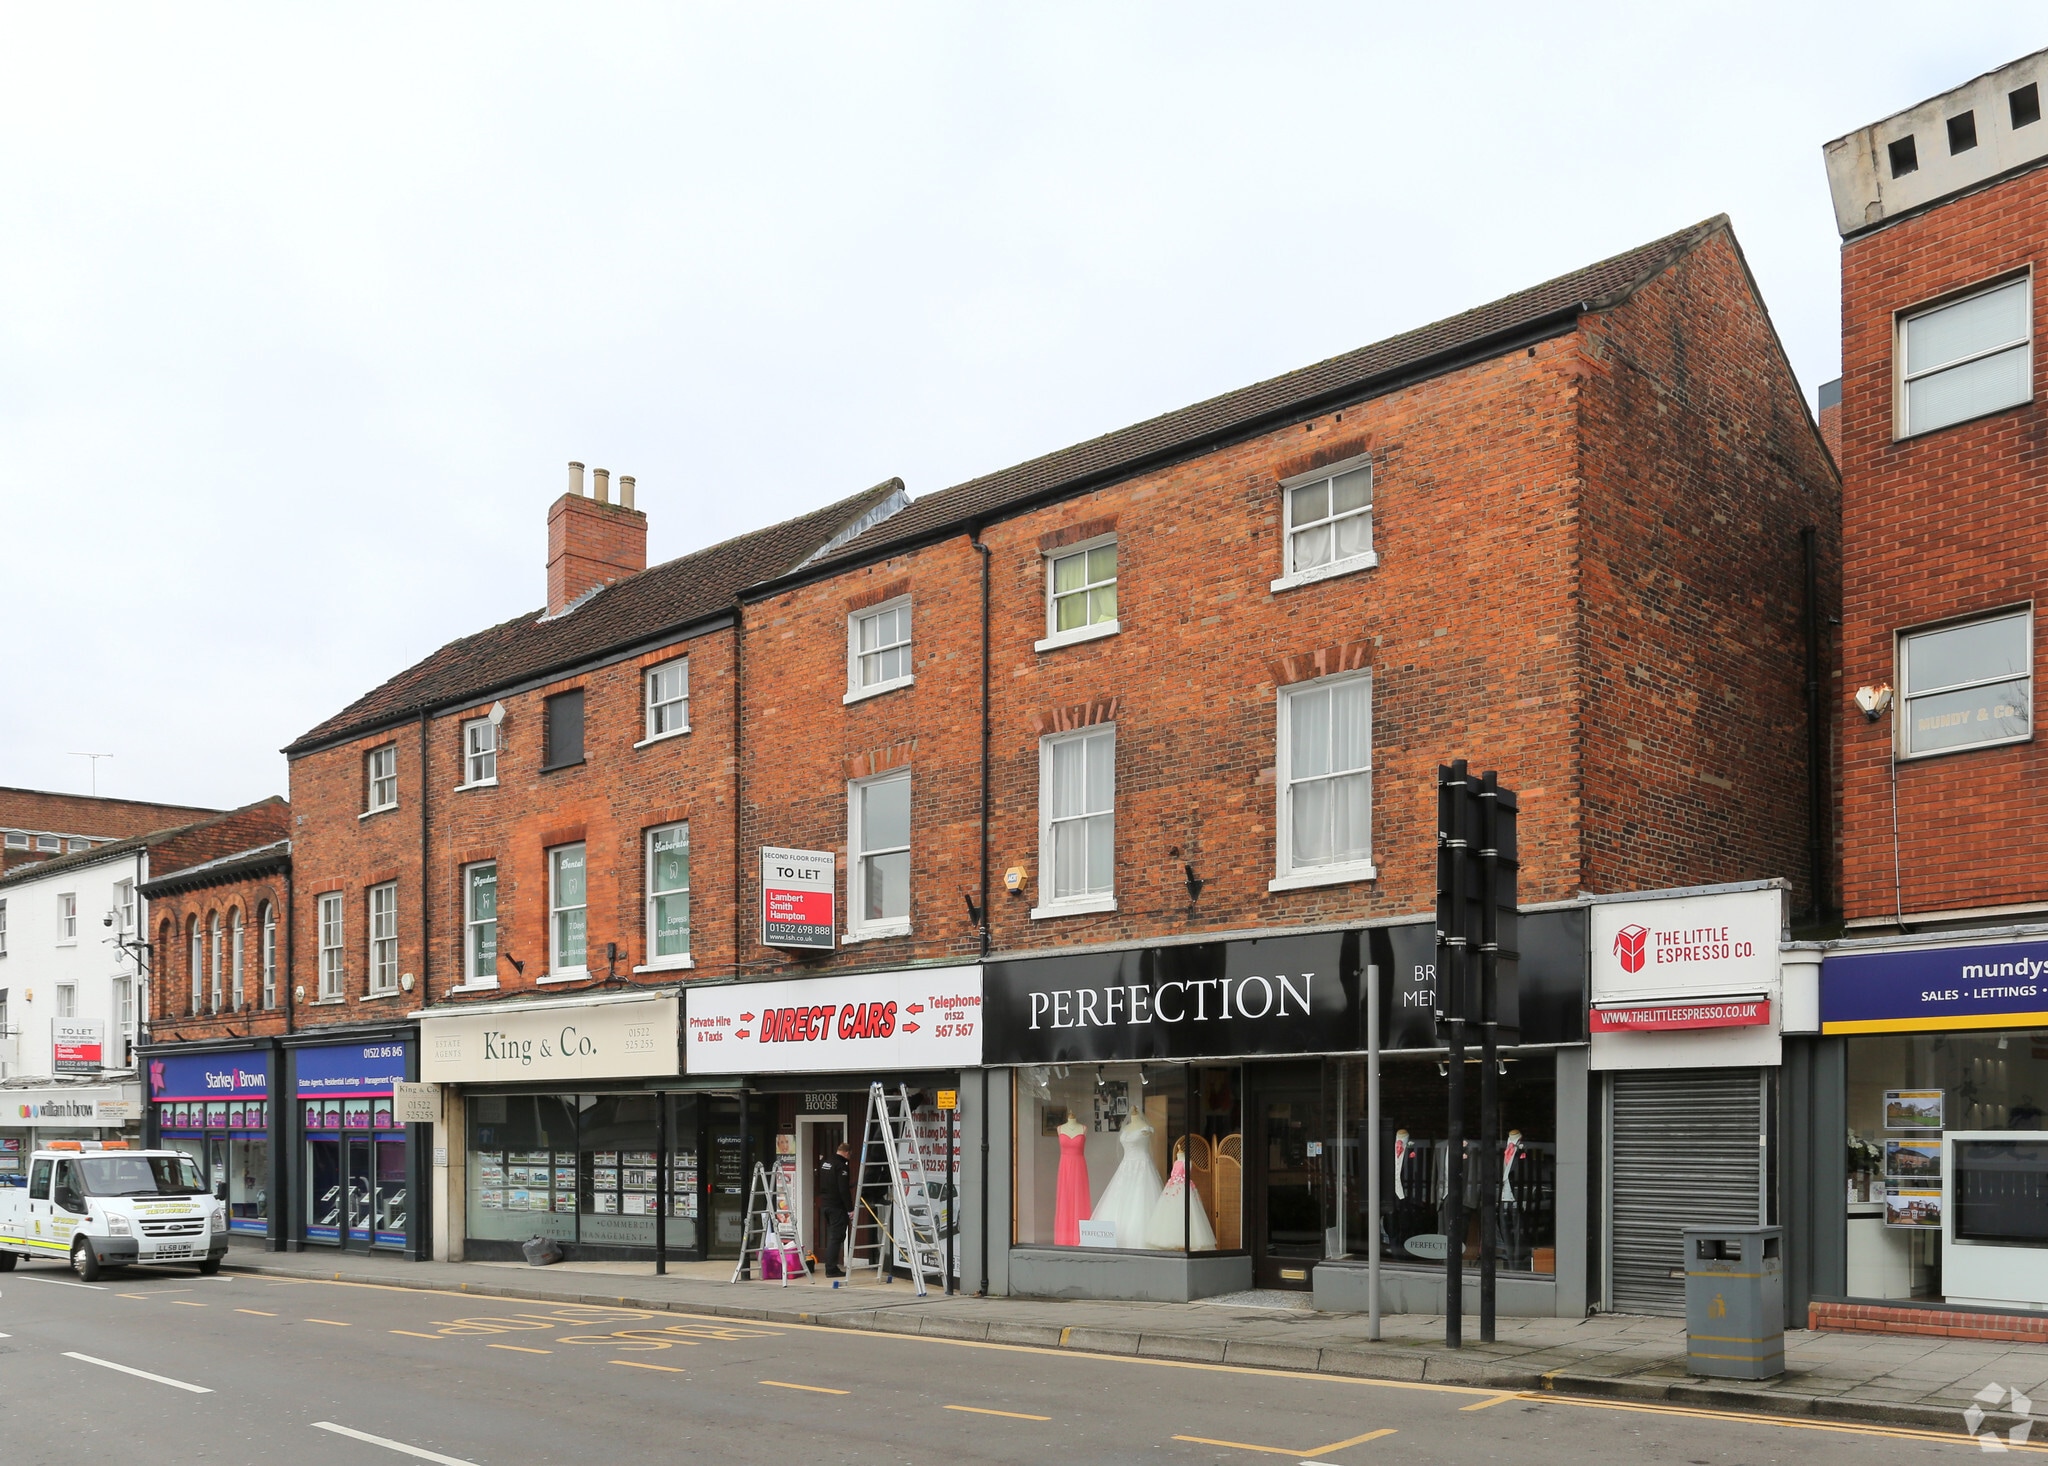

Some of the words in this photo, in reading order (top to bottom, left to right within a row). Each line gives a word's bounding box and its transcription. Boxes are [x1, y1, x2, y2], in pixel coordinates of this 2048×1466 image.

[1918, 710, 1971, 732] MUNDY
[1976, 708, 1989, 722] &
[1993, 705, 2019, 718] Co.
[654, 840, 690, 853] Laborator
[561, 858, 584, 870] Dental
[764, 852, 789, 860] SECOND
[790, 854, 810, 862] FLOOR
[810, 856, 834, 864] OFFICES
[776, 867, 794, 878] TO
[798, 869, 820, 880] LET
[770, 892, 804, 903] Lambert
[770, 902, 793, 911] Smith
[667, 916, 688, 925] Express
[770, 911, 806, 921] Hampton
[573, 922, 585, 931] Days
[659, 928, 679, 938] Denture
[679, 927, 690, 935] Rep
[769, 923, 796, 933] 01522
[797, 925, 813, 935] 698
[814, 926, 831, 936] 888
[572, 933, 585, 941] week
[769, 934, 813, 942] www.lsh.co.uk
[1655, 931, 1680, 946] THE
[1684, 926, 1729, 945] LITTLE
[1656, 943, 1730, 964] ESPRESSO
[1734, 941, 1756, 958] CO.
[1414, 964, 1436, 981] BR
[1403, 990, 1436, 1007] MEN
[1921, 989, 1959, 1002] SALES
[1973, 985, 2037, 999] LETTINGS
[928, 994, 981, 1010] Telephone
[1028, 973, 1315, 1031] PERFECTION
[944, 1011, 965, 1021] 01522
[1601, 1005, 1757, 1025] WWW.THELITTLEESPRESSO.CO.UK
[689, 1017, 715, 1028] Private
[716, 1016, 731, 1027] Hire
[759, 1005, 836, 1043] DIRECT
[837, 1001, 898, 1040] CARS
[628, 1027, 650, 1038] 01522
[697, 1031, 704, 1042] &
[704, 1030, 723, 1042] Taxis
[935, 1025, 953, 1038] 567
[955, 1023, 974, 1036] 567
[435, 1040, 461, 1048] ESTATE
[483, 1031, 532, 1066] King
[540, 1039, 553, 1058] &
[560, 1026, 597, 1057] Co.
[625, 1040, 639, 1050] 525
[640, 1039, 654, 1049] 255
[363, 1048, 380, 1058] 01522
[381, 1047, 391, 1058] 845
[392, 1046, 403, 1057] 845
[434, 1050, 462, 1058] AGENTS
[205, 1071, 234, 1091] Starkey
[239, 1070, 266, 1087] Brown
[299, 1079, 310, 1087] Estate
[311, 1079, 324, 1088] Agents,
[324, 1077, 344, 1086] Residential
[345, 1077, 360, 1087] Lettings
[364, 1076, 389, 1086] Management
[399, 1085, 417, 1093] King
[805, 1093, 839, 1102] BROOK
[66, 1100, 72, 1117] h
[73, 1100, 93, 1117] brow
[408, 1101, 431, 1109] 01522
[806, 1102, 838, 1110] HOUSE
[406, 1111, 434, 1119] 525255
[911, 1111, 927, 1121] rivate
[925, 1126, 939, 1141] Long
[717, 1136, 742, 1145] rightmo
[600, 1219, 655, 1230] COMMERCIA
[1410, 1241, 1447, 1250] PERFECTI
